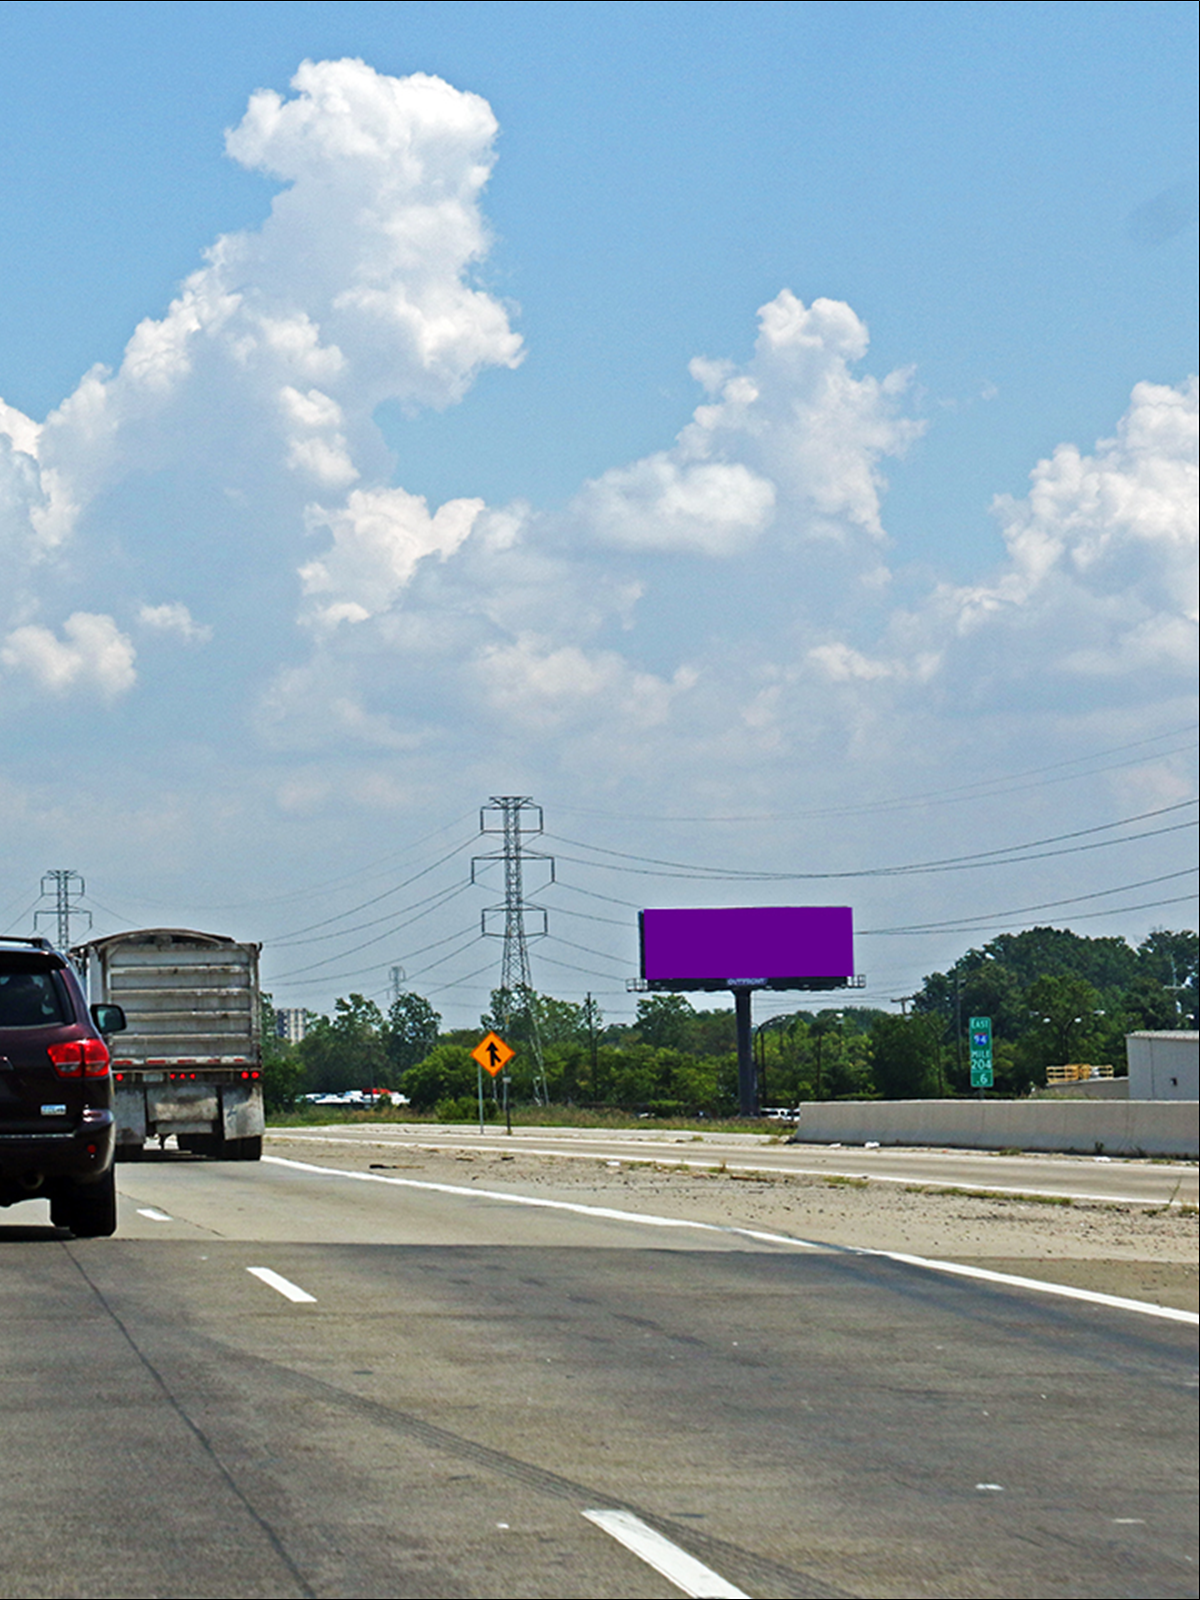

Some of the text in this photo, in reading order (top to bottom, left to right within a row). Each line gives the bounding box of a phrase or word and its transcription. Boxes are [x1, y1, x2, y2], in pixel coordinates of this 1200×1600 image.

[971, 1018, 989, 1029] EAST
[974, 1034, 987, 1043] 94
[971, 1059, 992, 1069] 204
